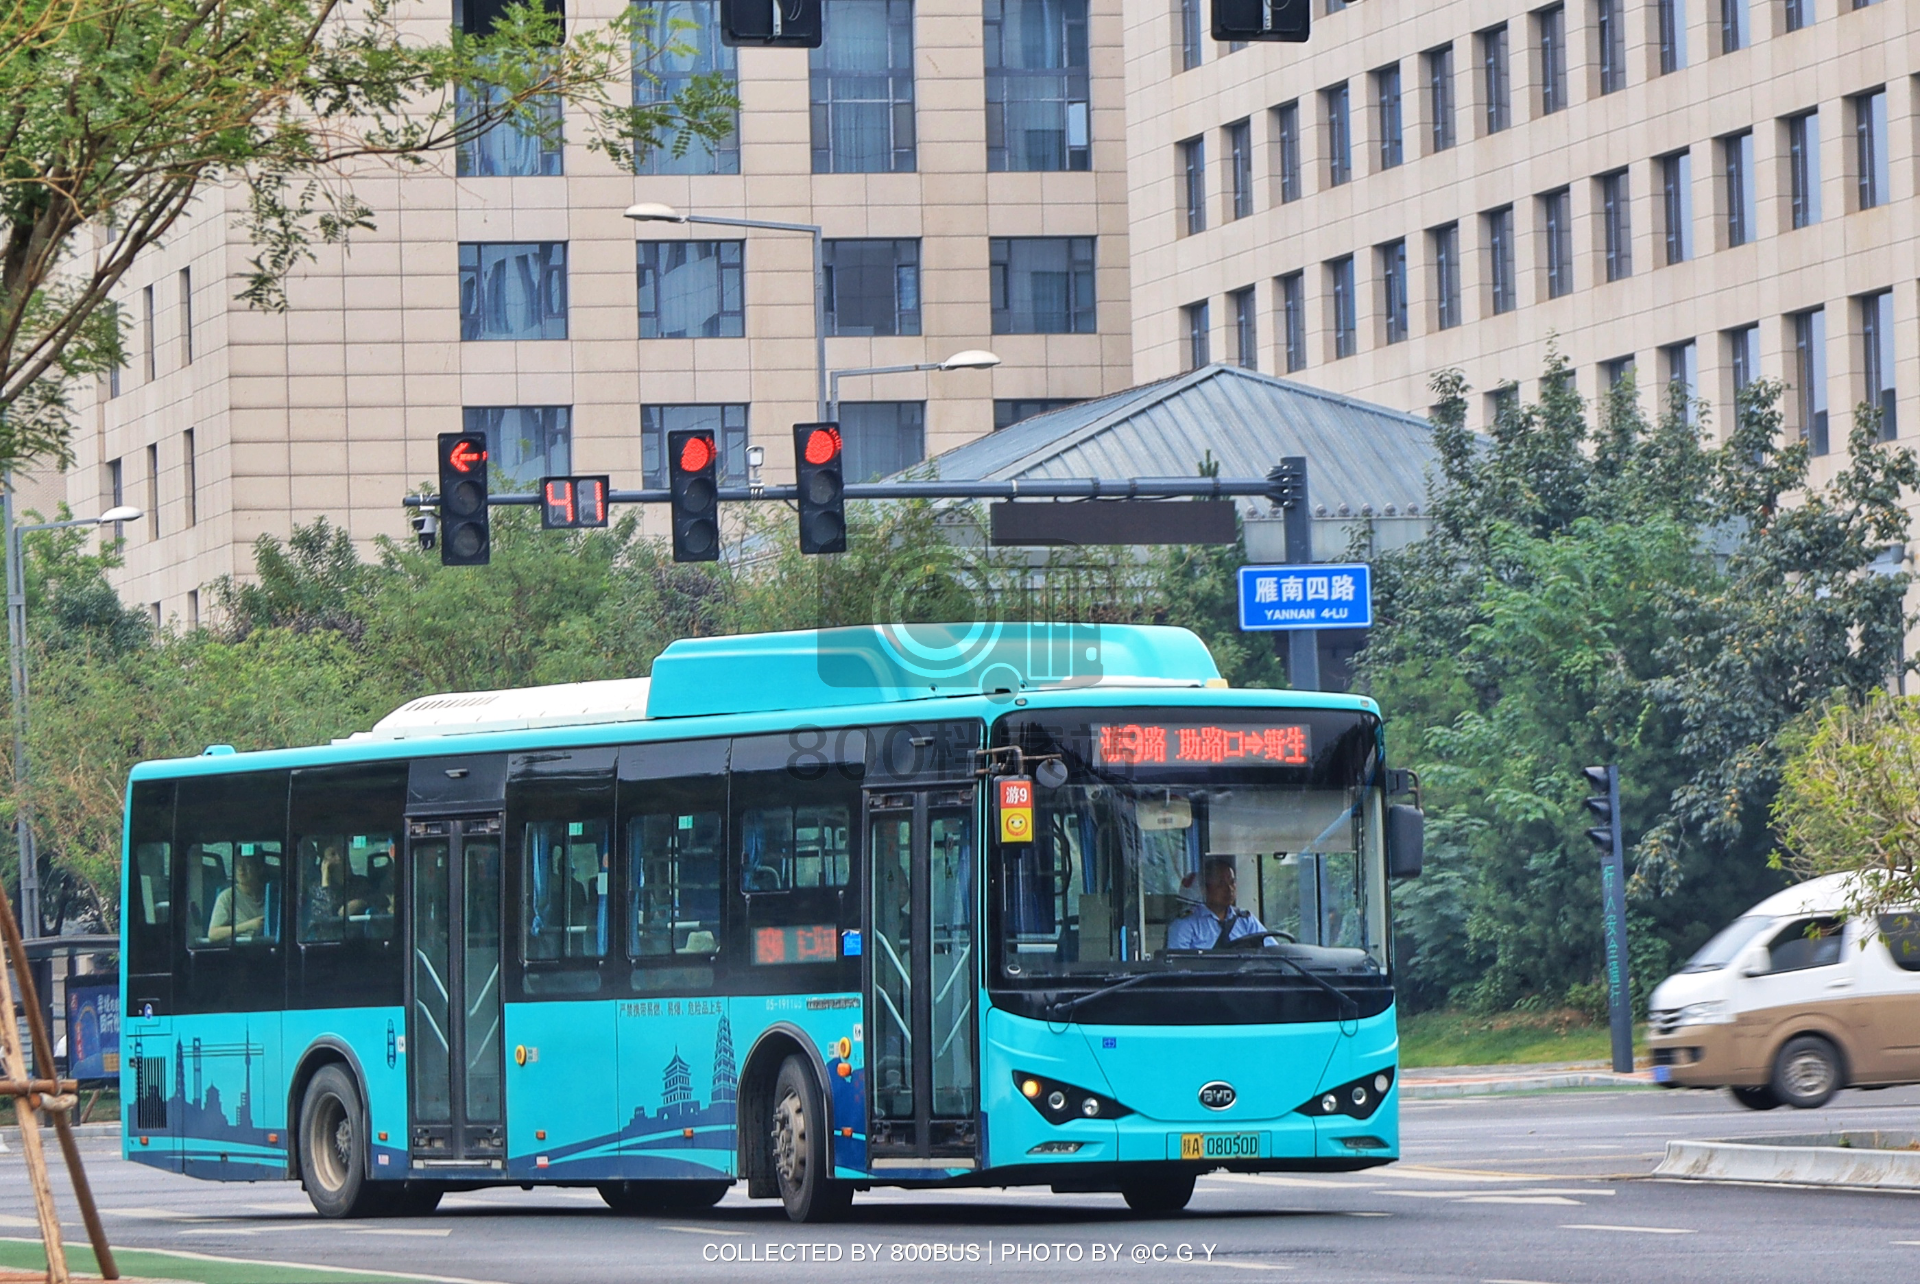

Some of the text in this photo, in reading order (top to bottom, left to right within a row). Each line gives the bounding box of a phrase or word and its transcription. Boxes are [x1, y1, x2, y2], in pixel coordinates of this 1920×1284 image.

[545, 481, 604, 522] 41
[1254, 574, 1355, 603] 雁南四路
[1264, 608, 1315, 621] YANNAN
[1005, 785, 1028, 804] 游9
[1203, 1090, 1233, 1102] BYD
